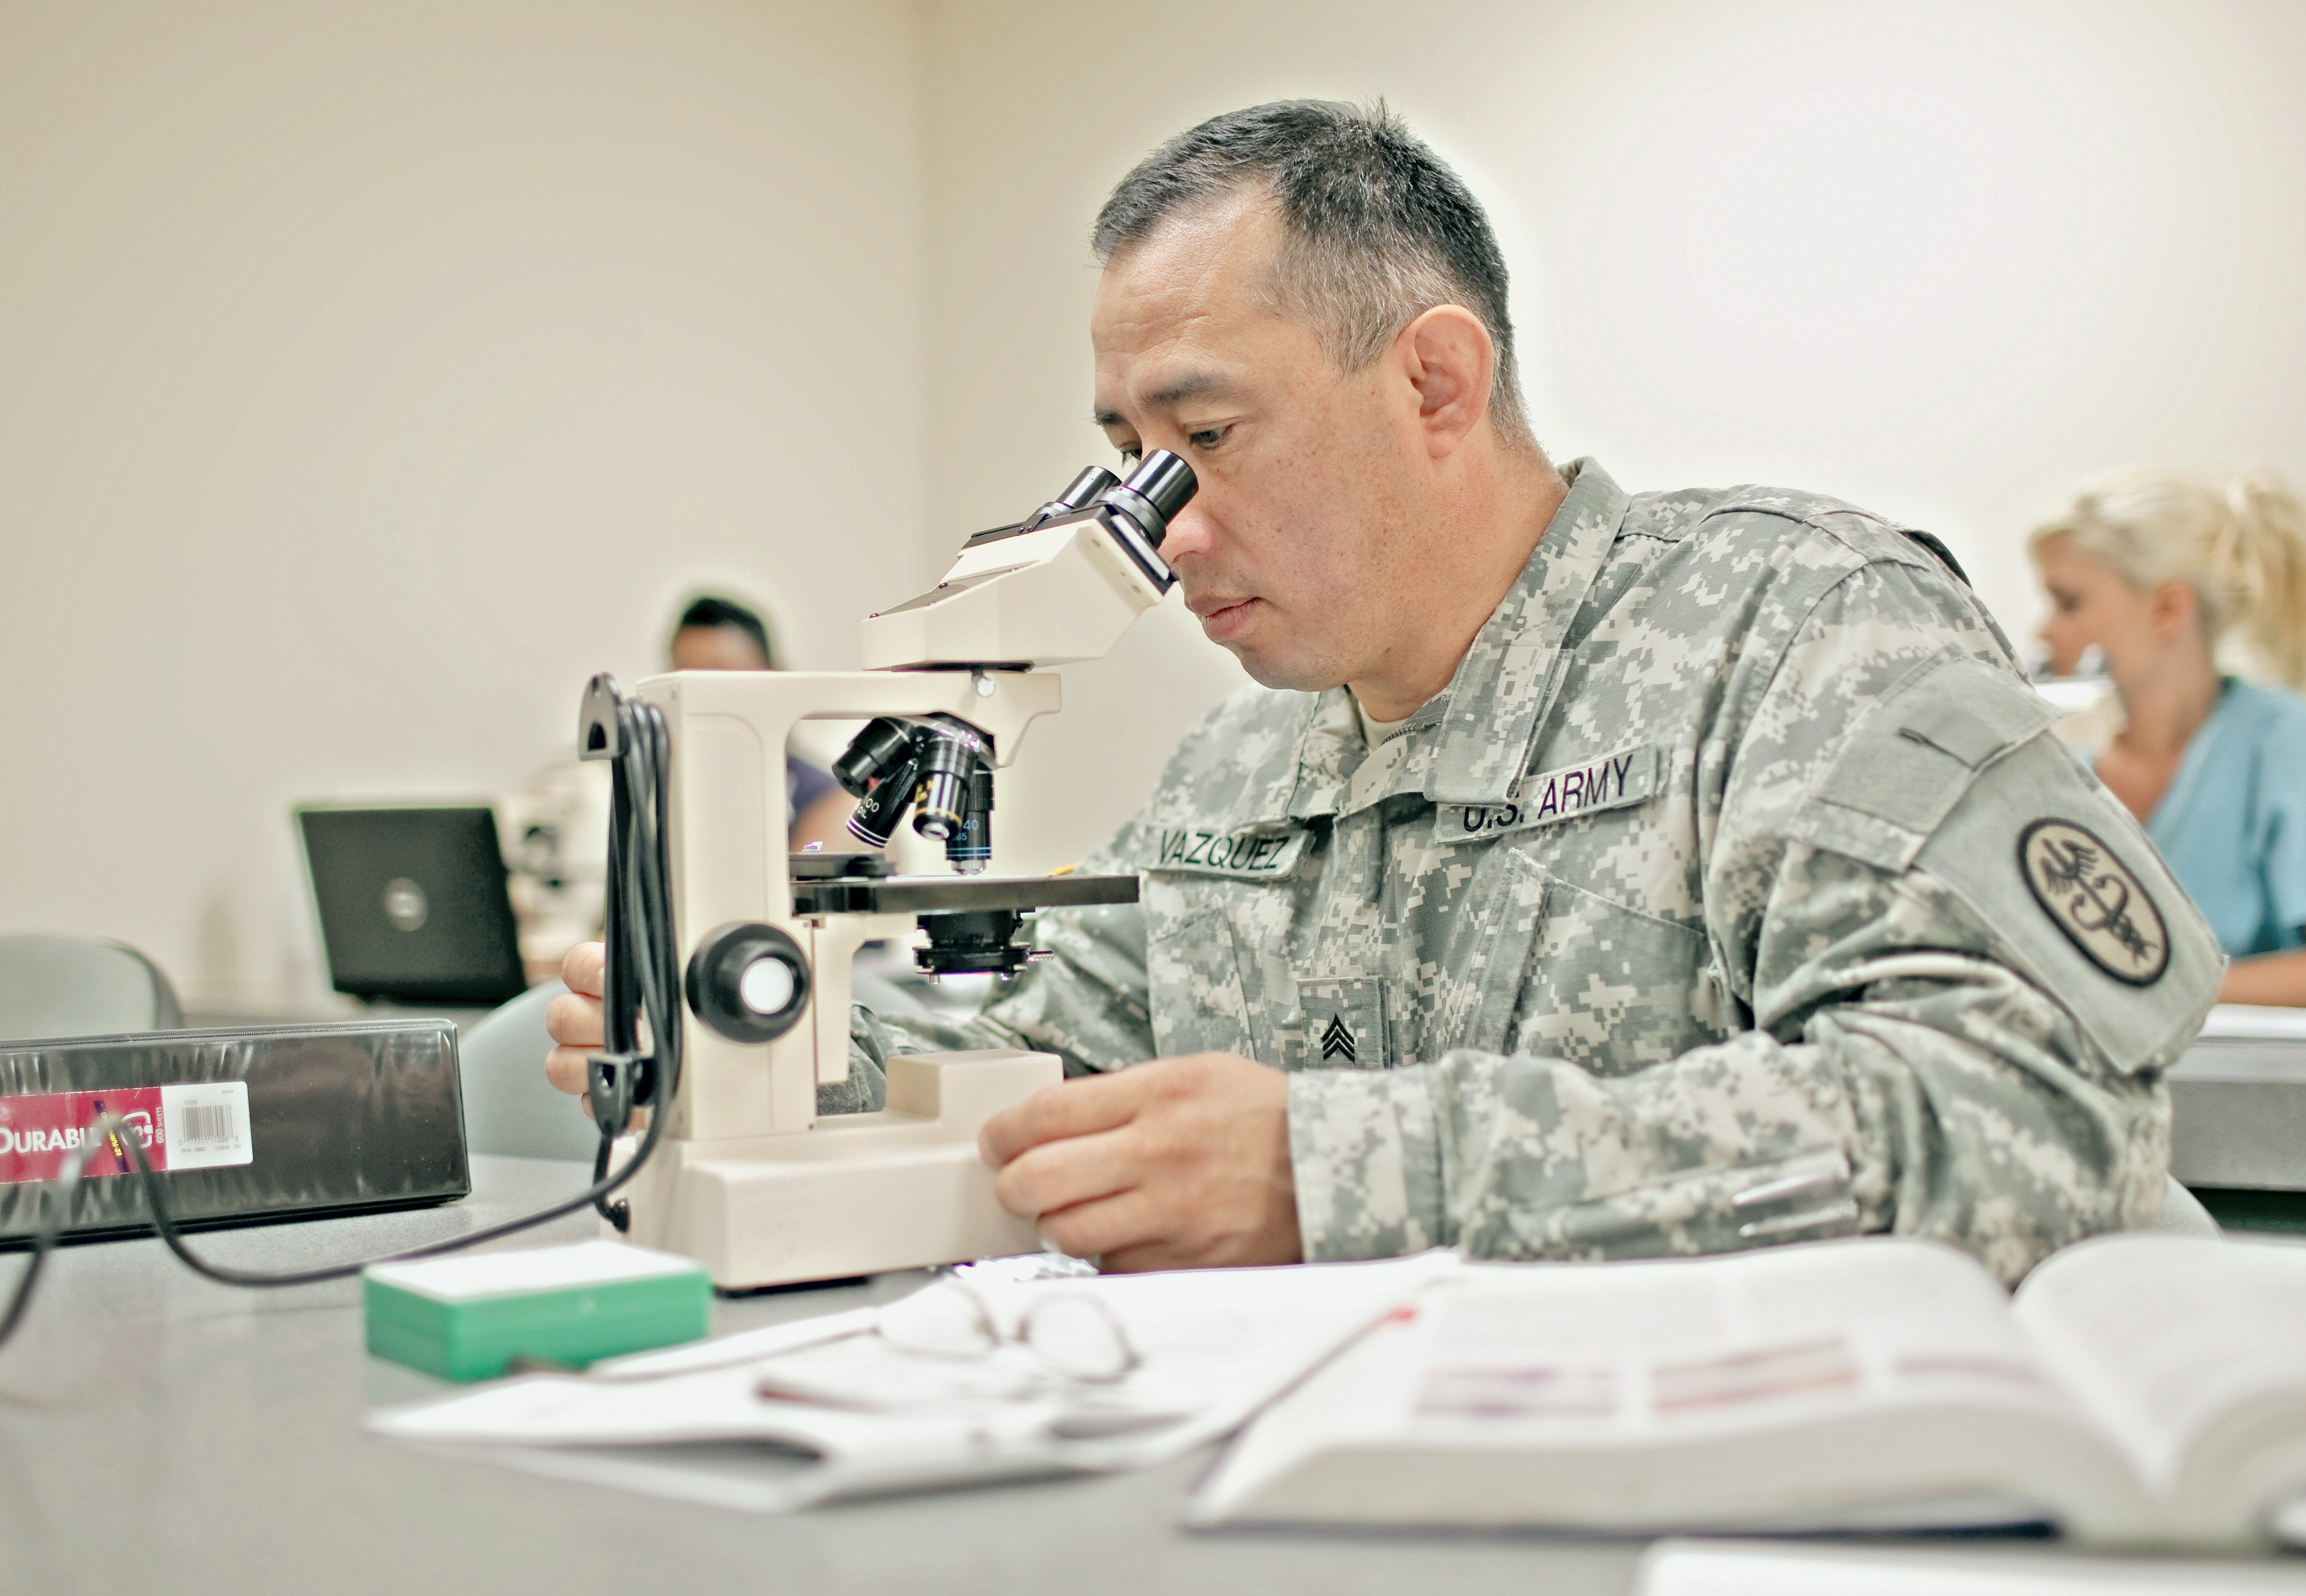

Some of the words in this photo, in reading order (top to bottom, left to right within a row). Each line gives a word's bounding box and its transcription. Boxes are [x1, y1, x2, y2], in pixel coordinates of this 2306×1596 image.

[1463, 795, 1525, 832] U.S.
[1537, 754, 1633, 819] ARMY
[857, 806, 867, 819] OIL
[963, 819, 979, 830] 40
[1160, 830, 1290, 871] VAZQUEZ
[156, 1106, 164, 1128] SHEETS
[156, 1128, 164, 1144] 600
